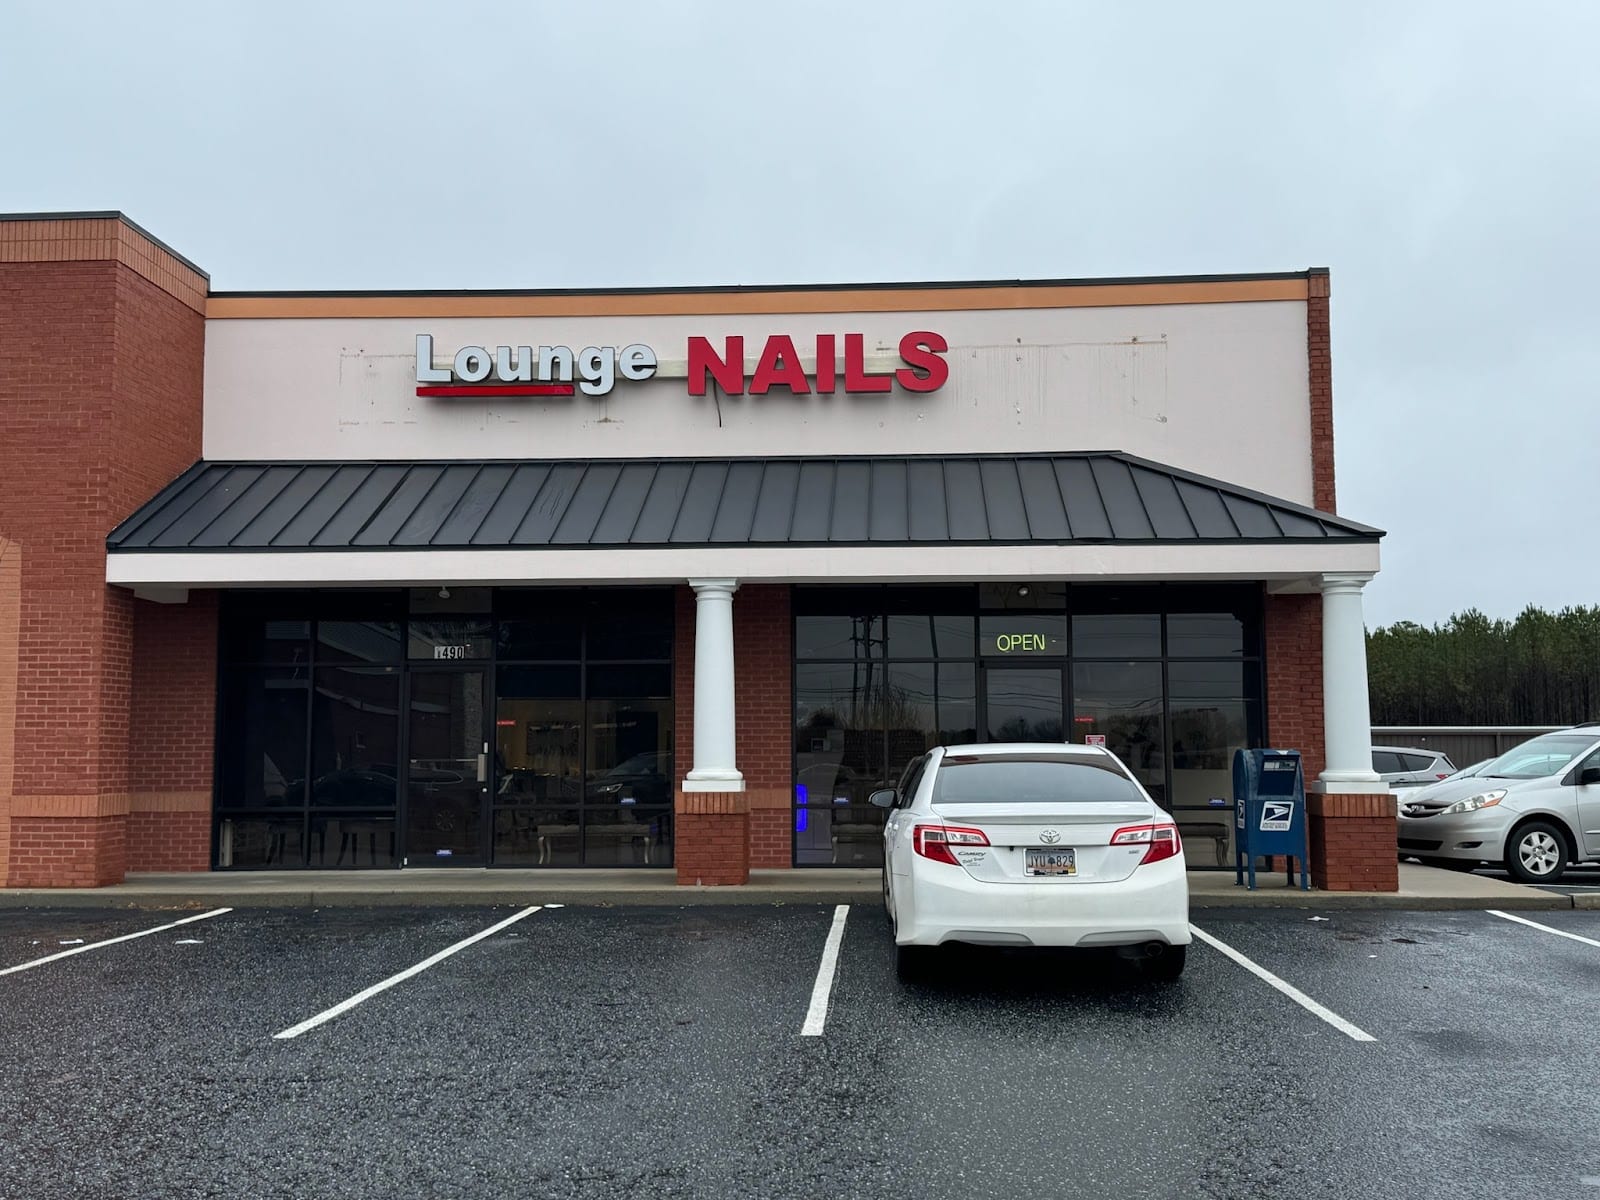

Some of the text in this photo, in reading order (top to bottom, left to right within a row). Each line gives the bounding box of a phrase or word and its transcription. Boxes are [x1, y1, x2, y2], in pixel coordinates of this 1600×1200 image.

[415, 331, 949, 396] Lounge NAILS
[997, 634, 1046, 652] OPEN
[1028, 855, 1074, 868] JYU 829
